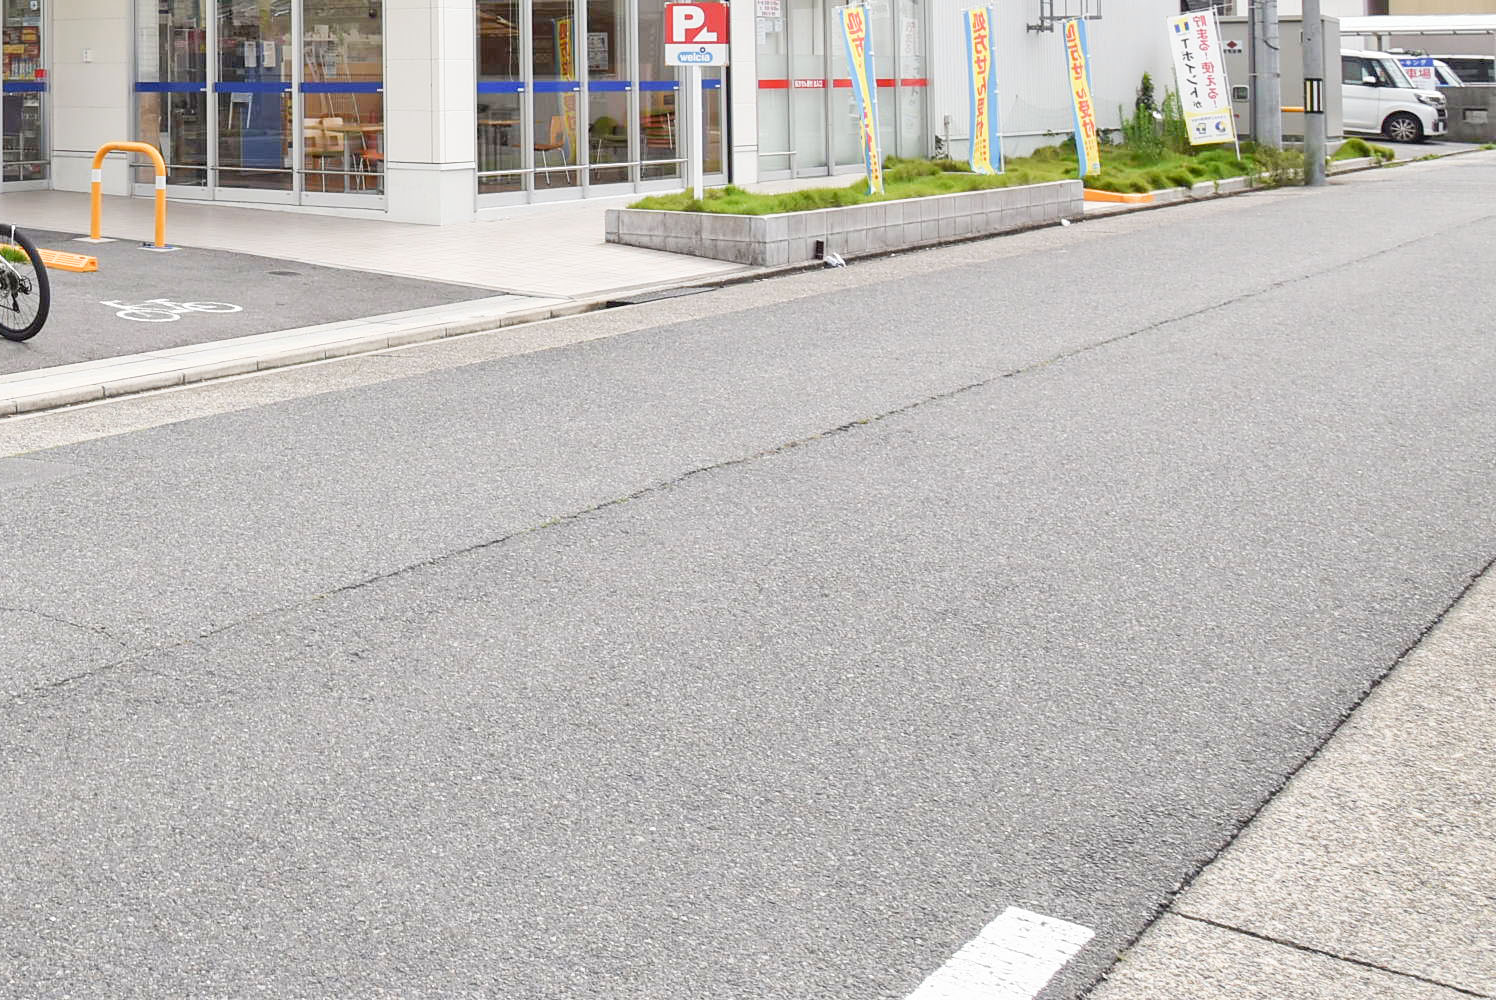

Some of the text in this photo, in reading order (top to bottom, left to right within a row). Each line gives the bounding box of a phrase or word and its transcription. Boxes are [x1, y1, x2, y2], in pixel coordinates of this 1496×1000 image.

[673, 6, 705, 42] P
[679, 52, 710, 62] welcia
[1406, 68, 1432, 79] 車場
